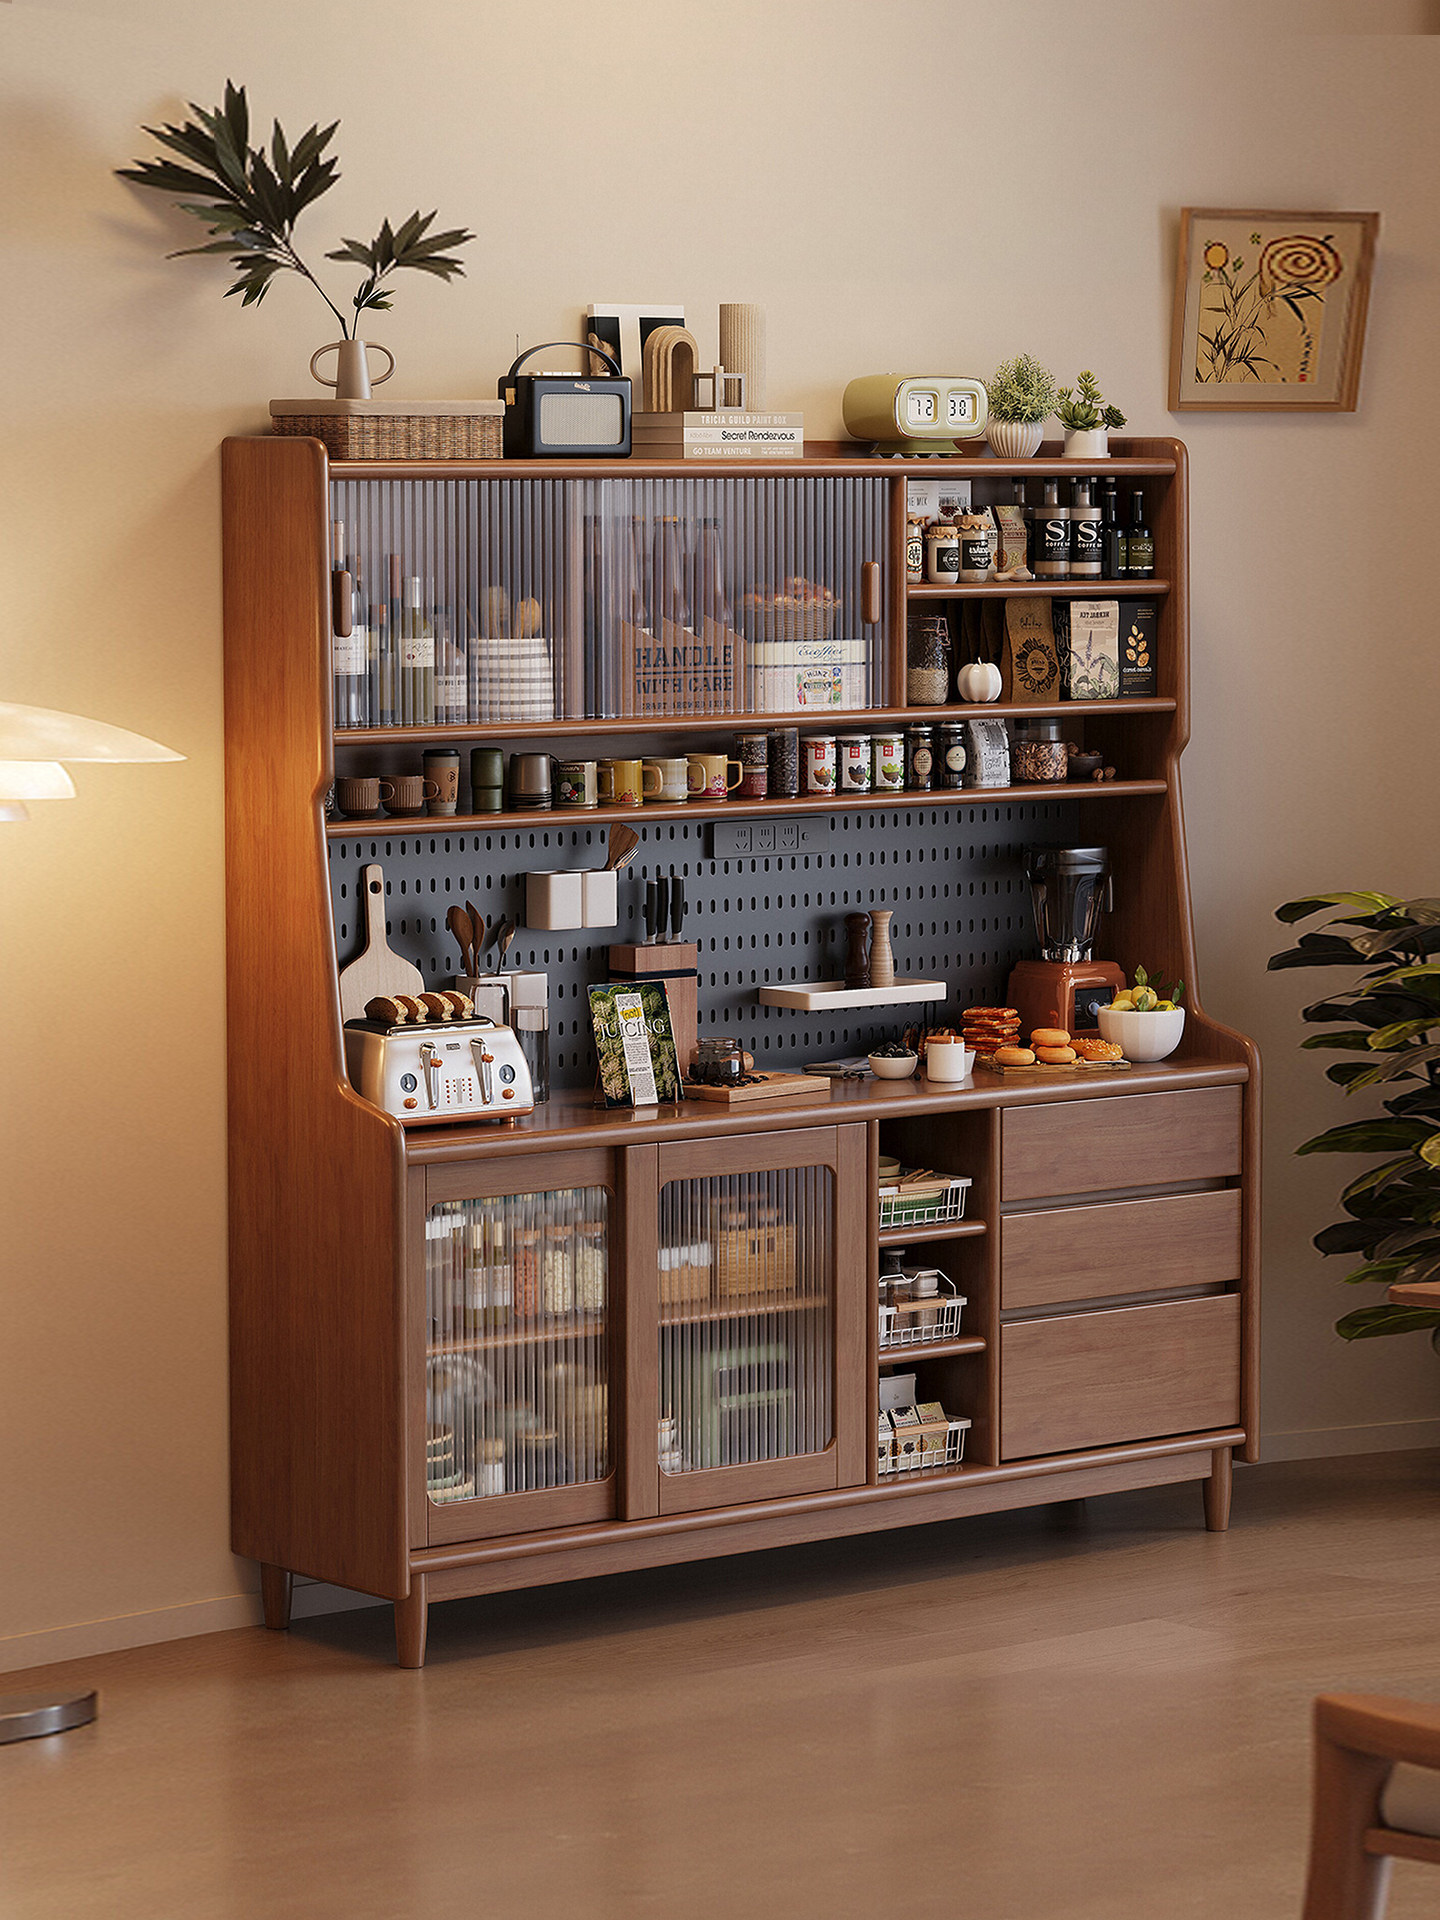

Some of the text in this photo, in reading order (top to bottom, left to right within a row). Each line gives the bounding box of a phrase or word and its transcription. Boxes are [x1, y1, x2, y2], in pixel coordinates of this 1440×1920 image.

[701, 415, 726, 425] TRICIA
[753, 415, 772, 425] PAINT
[774, 415, 787, 425] BOX
[721, 430, 796, 441] Secret Rendezvous
[692, 447, 703, 456] GO
[704, 447, 722, 455] TEAM
[723, 447, 752, 455] VENTURE
[636, 645, 732, 668] HANDLE
[636, 676, 732, 694] WITH CARE
[601, 1018, 665, 1042] JUICING
